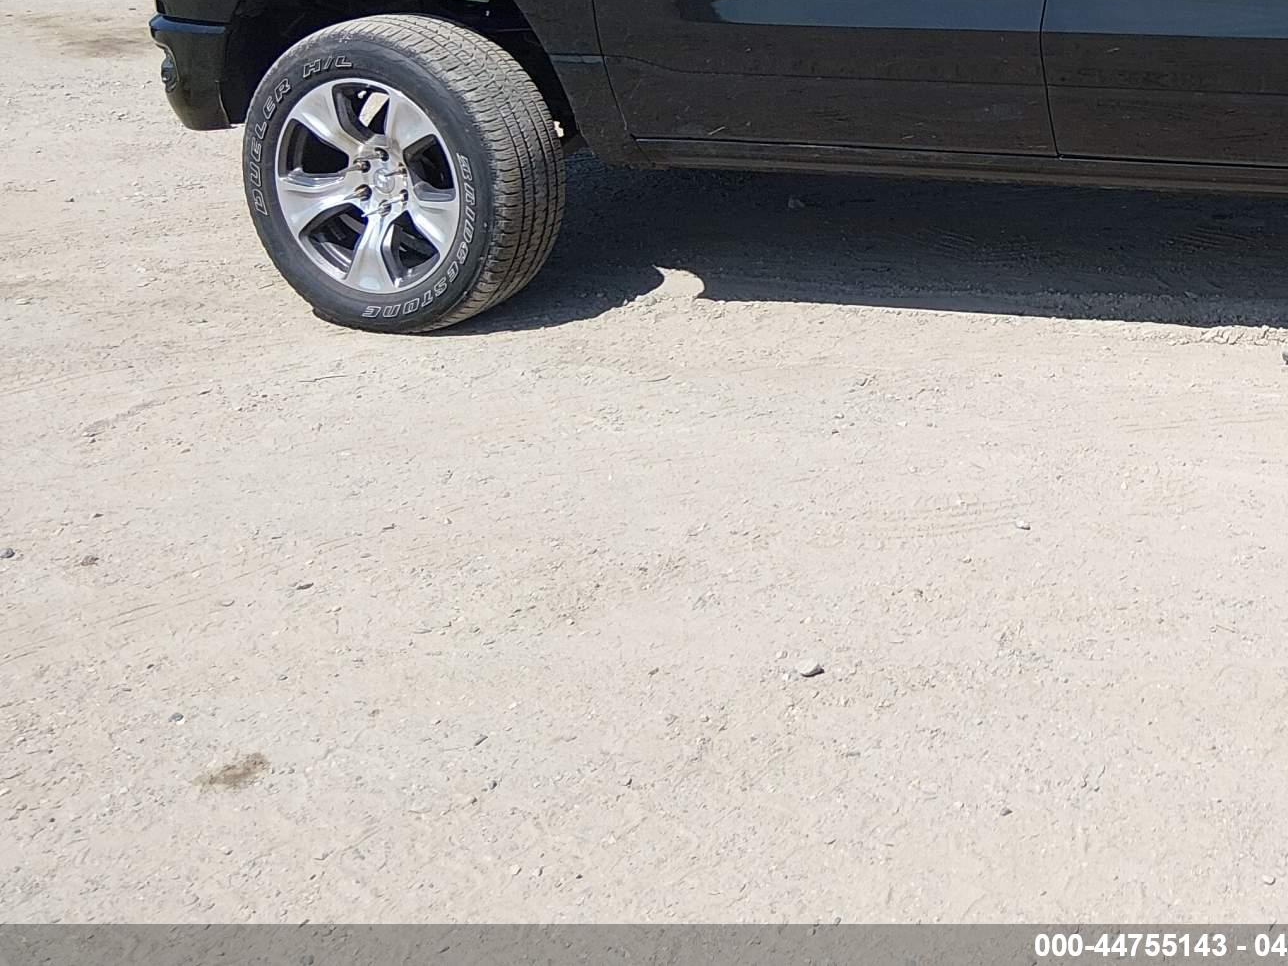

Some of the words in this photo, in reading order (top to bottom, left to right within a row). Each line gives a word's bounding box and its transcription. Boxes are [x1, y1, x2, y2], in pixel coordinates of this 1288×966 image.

[249, 78, 291, 216] DUELER
[302, 54, 353, 79] H/L
[361, 152, 478, 319] BRIDGESTONE
